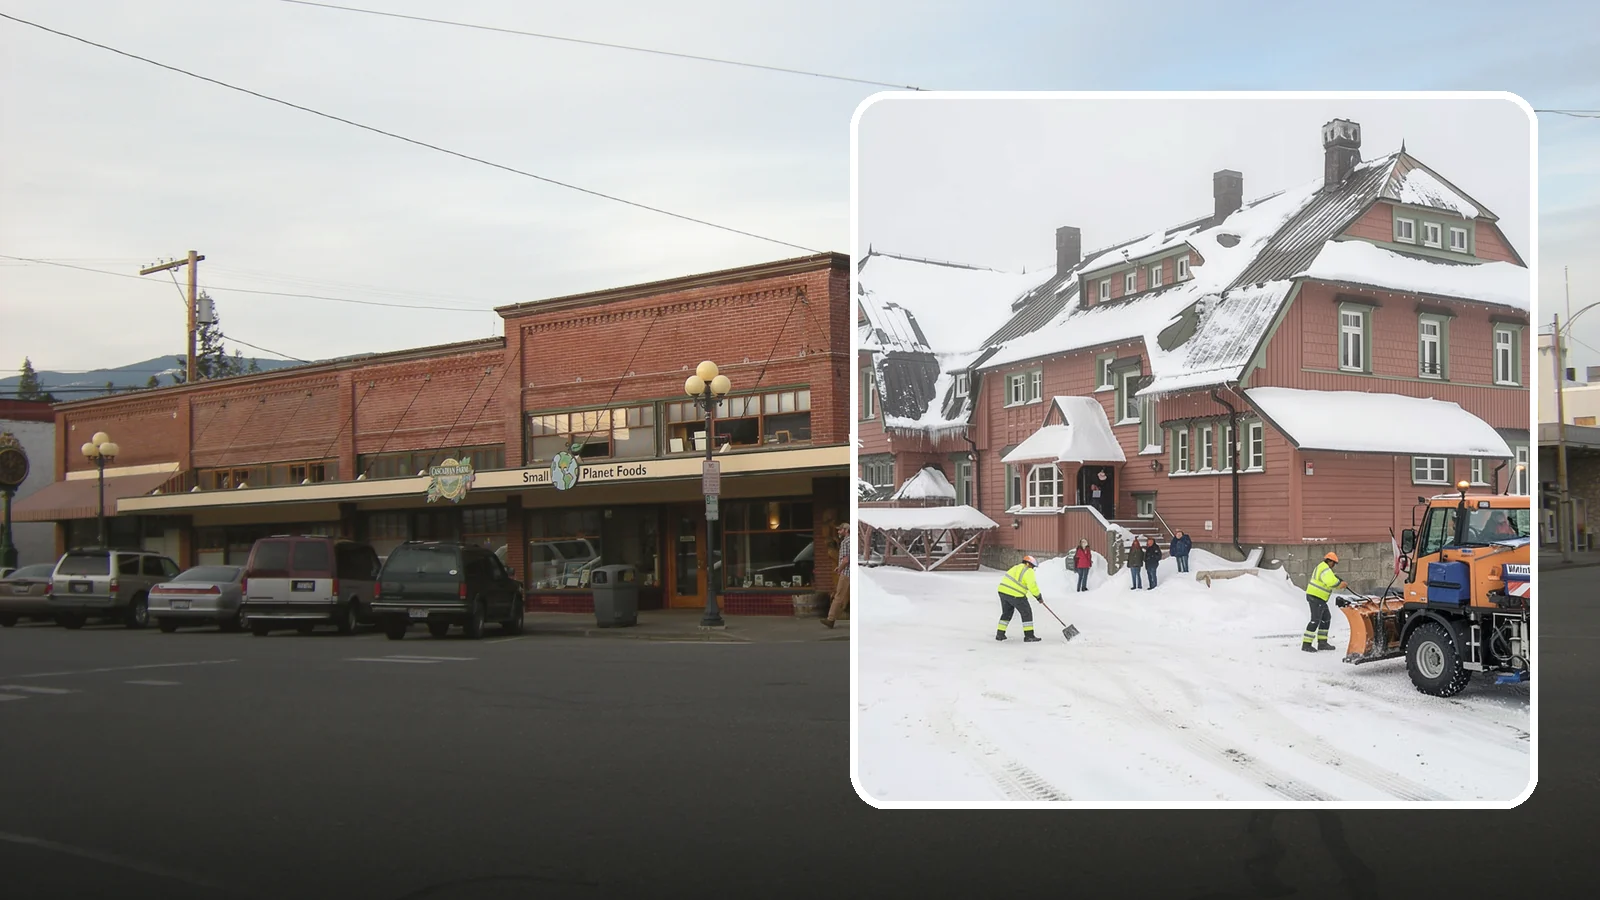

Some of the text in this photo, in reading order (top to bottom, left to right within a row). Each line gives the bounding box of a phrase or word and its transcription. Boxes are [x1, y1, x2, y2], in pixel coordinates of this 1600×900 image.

[431, 465, 469, 476] CASCADIAN FARM
[523, 464, 647, 483] Small Planet Foods
